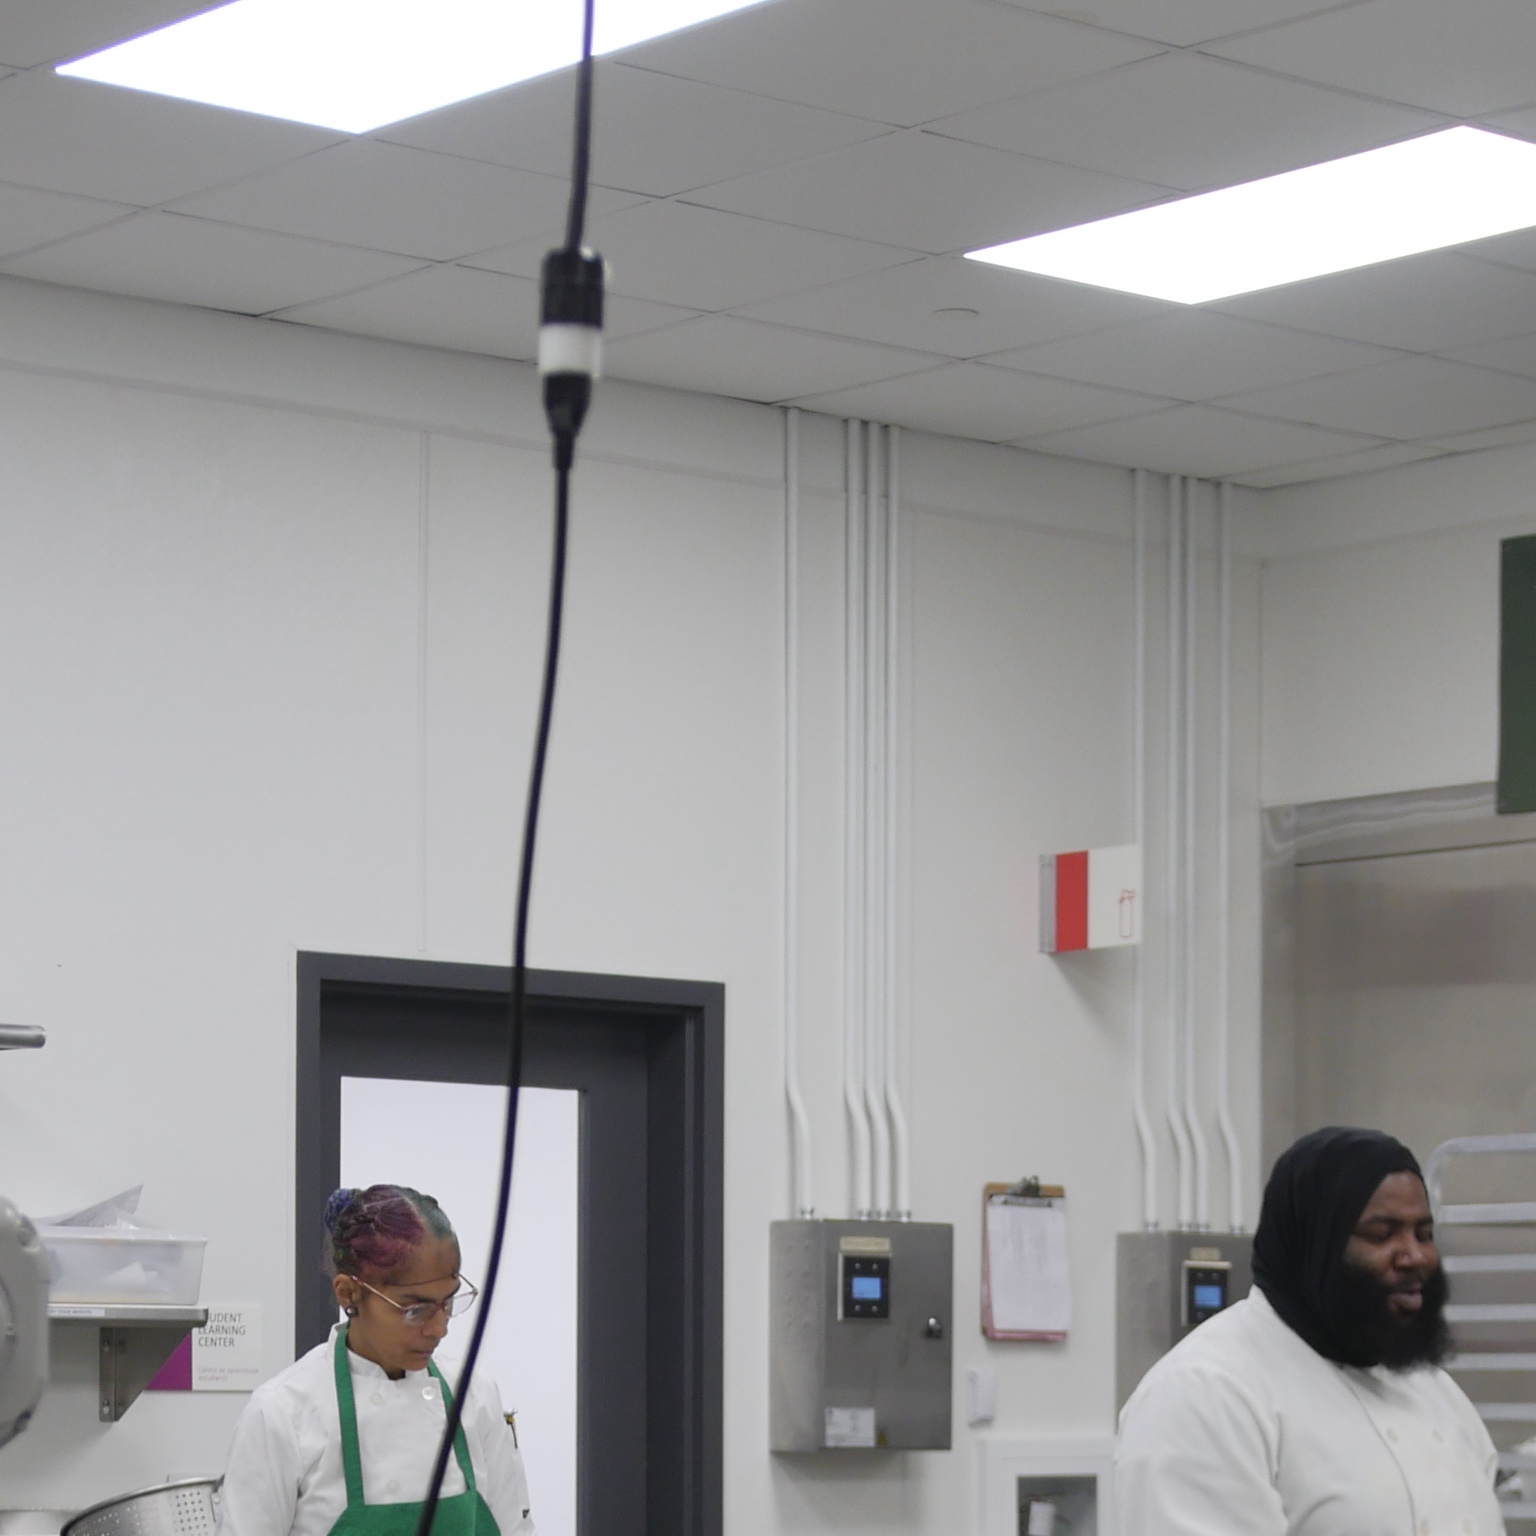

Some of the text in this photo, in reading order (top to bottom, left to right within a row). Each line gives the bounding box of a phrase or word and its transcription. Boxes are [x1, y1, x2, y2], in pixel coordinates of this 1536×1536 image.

[209, 1312, 243, 1323] UDENT
[198, 1325, 246, 1336] LEARNING
[198, 1337, 235, 1347] CENTER
